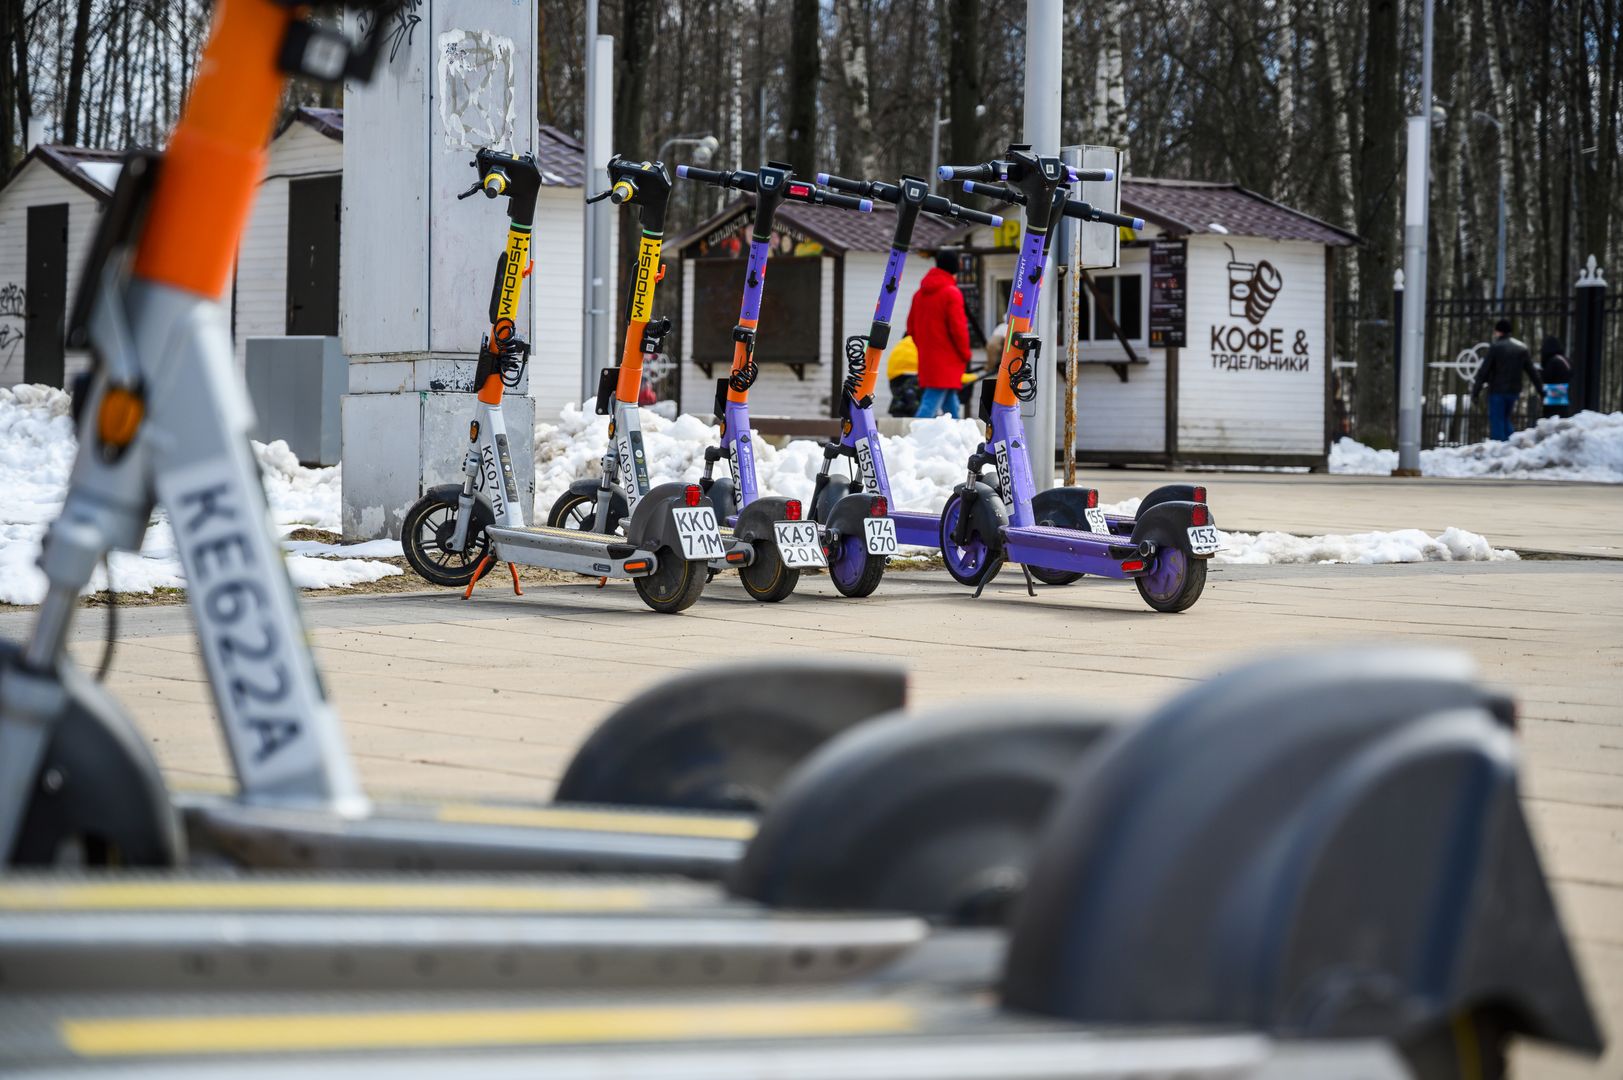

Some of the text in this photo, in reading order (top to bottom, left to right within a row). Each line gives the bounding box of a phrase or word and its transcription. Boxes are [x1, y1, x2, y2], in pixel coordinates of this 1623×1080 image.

[500, 236, 524, 316] WHOOSH
[633, 242, 653, 318] WHOOSH
[1211, 325, 1309, 356] КОФЕ &
[1211, 354, 1309, 372] ТРДЕЛЬНИКИ
[996, 444, 1013, 506] 153831
[1086, 510, 1104, 524] 155
[868, 520, 893, 536] 174
[1190, 528, 1217, 544] 153
[869, 536, 896, 552] 670
